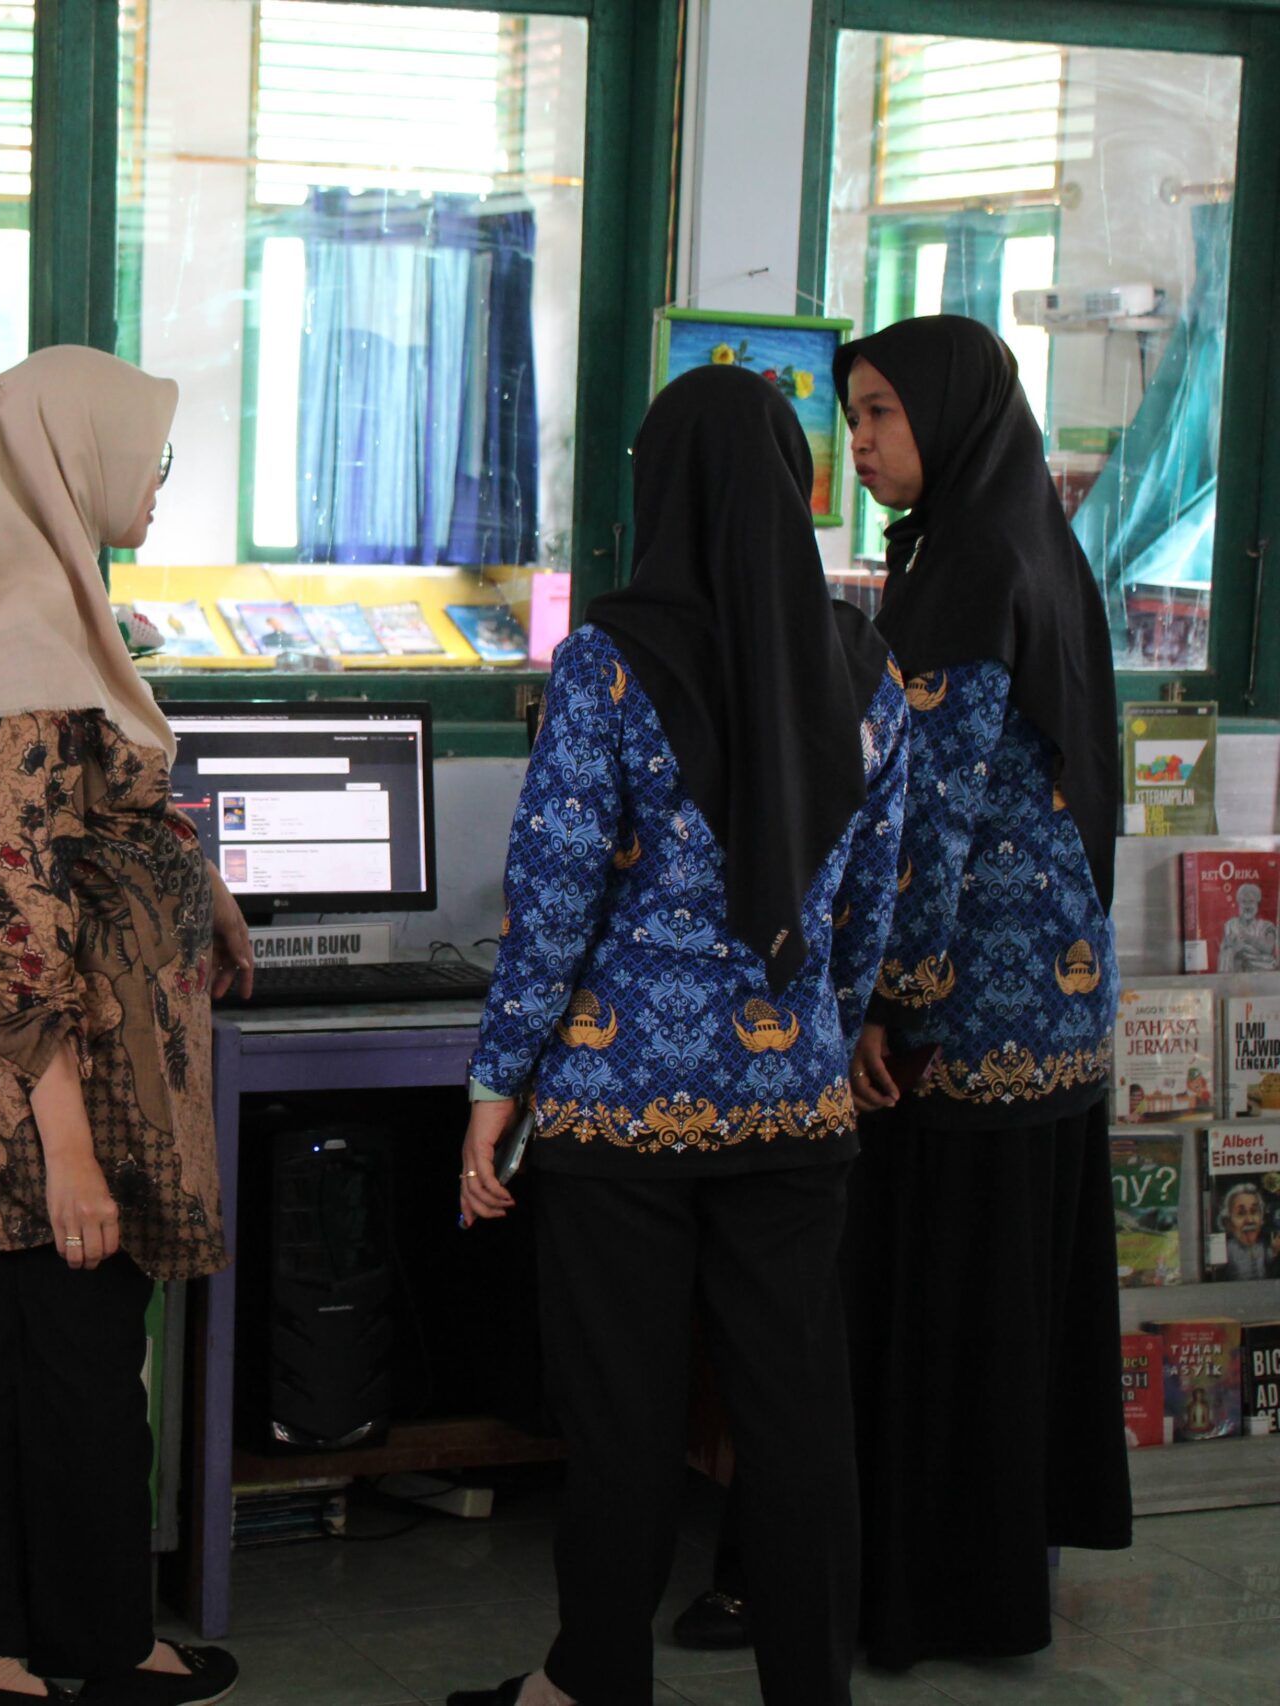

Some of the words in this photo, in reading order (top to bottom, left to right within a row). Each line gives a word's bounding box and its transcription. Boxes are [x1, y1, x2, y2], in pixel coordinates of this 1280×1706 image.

[1201, 861, 1259, 881] RETORIKA
[250, 936, 313, 959] CARIAN
[317, 934, 361, 955] BUKU
[1125, 1018, 1200, 1037] BAHASA
[1235, 1022, 1265, 1040] ILMU
[1127, 1038, 1199, 1056] JERMAN
[1235, 1039, 1280, 1057] TAJWID
[1235, 1058, 1280, 1071] LENGKAP
[1222, 1133, 1264, 1148] Albert
[1212, 1149, 1279, 1168] Einstein
[1170, 1343, 1222, 1355] TUHAN
